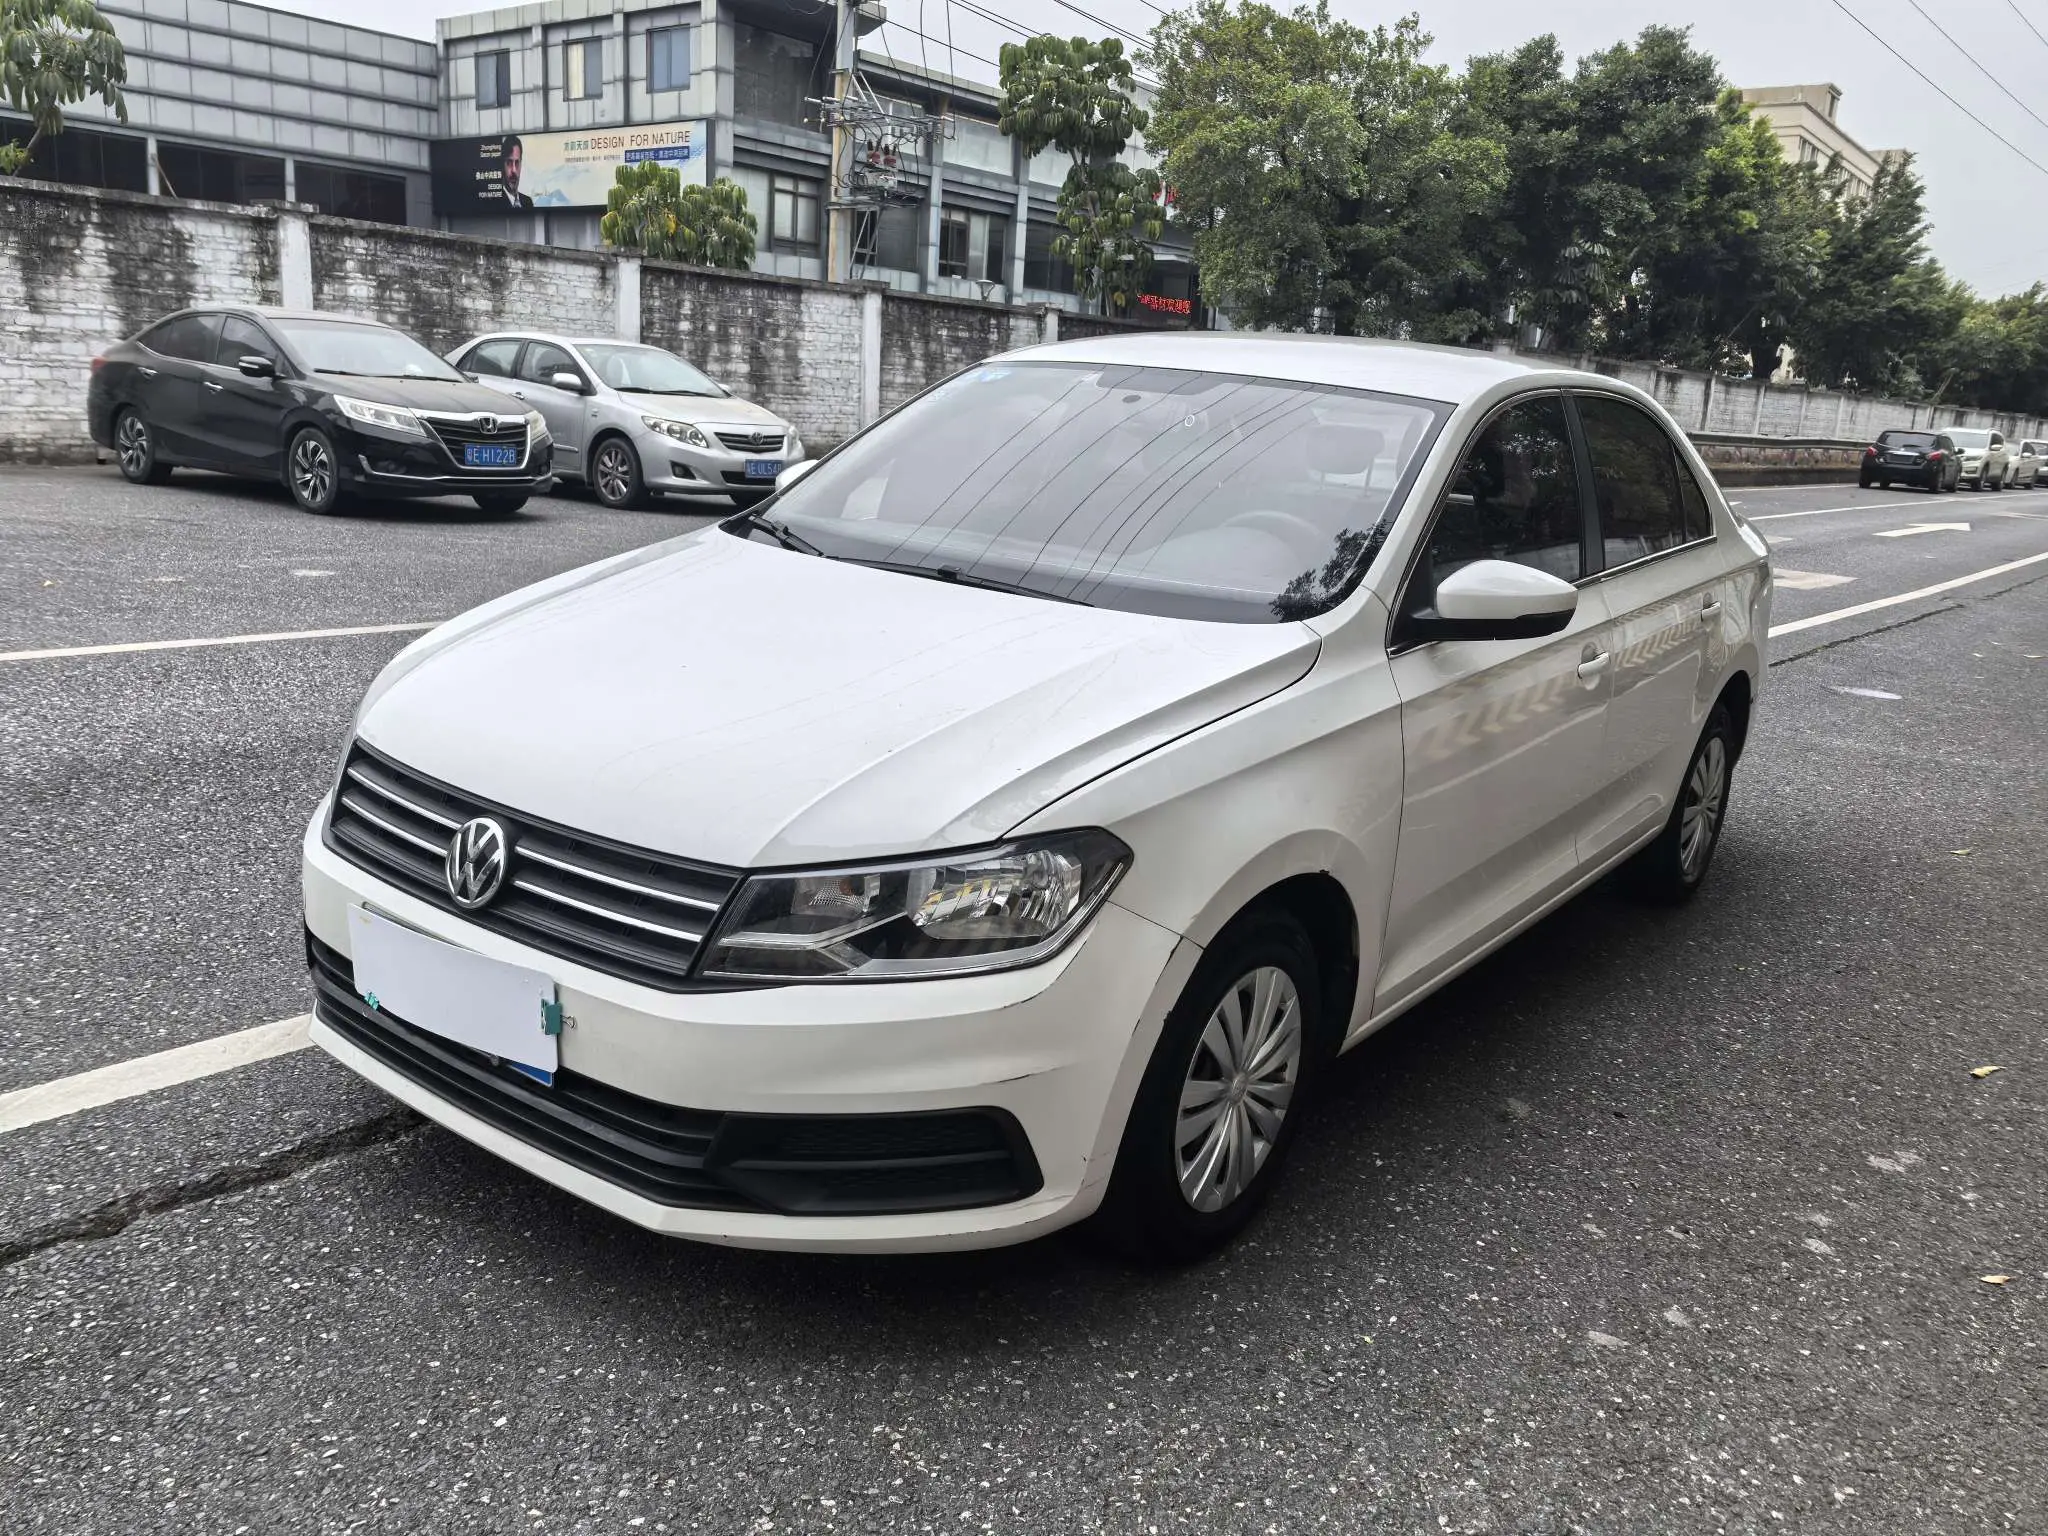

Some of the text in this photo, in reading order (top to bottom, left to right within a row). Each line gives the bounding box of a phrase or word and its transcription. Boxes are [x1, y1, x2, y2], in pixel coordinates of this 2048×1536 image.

[591, 131, 691, 150] DESIGN FOR NATURE
